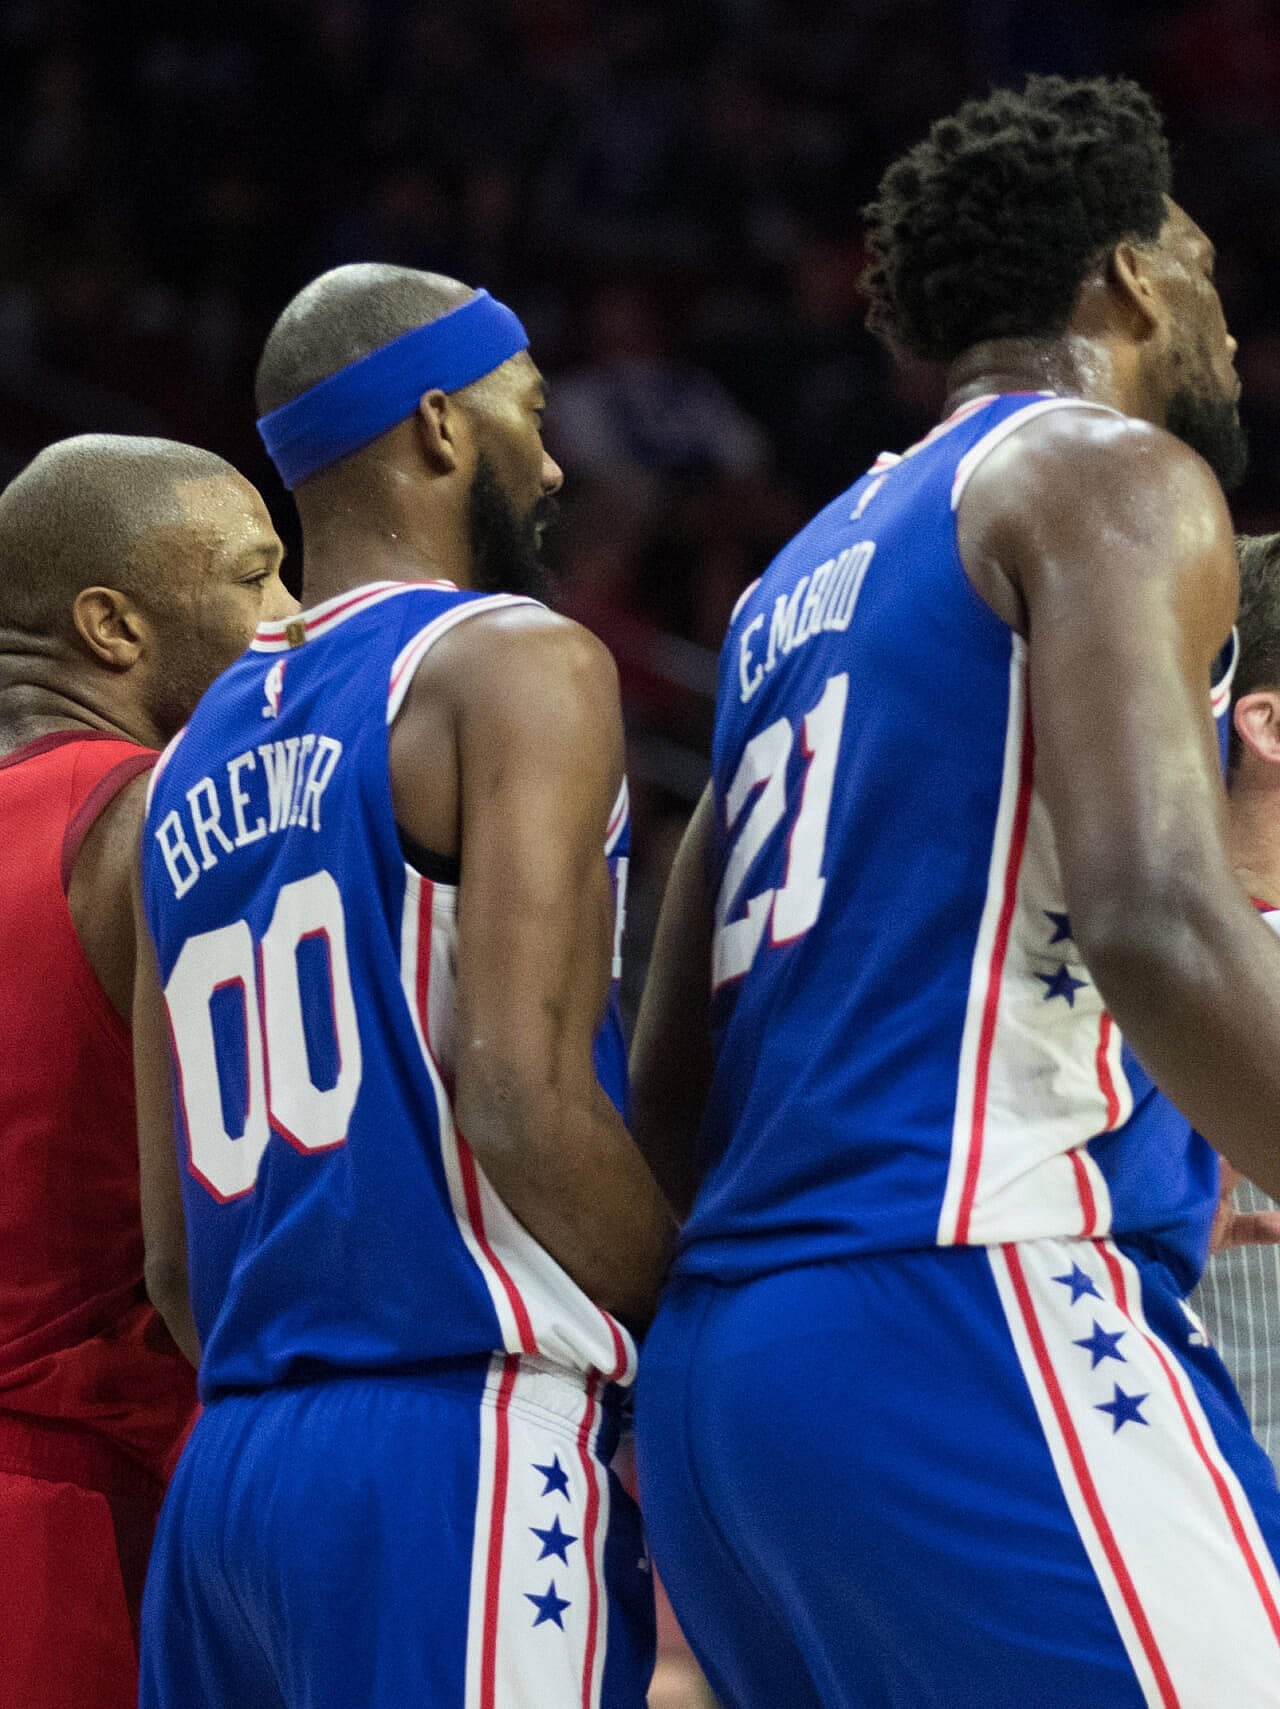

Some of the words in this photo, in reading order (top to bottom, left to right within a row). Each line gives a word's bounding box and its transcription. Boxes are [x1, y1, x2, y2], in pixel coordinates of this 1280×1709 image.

[154, 733, 344, 900] BREWER
[711, 671, 849, 993] 21
[162, 868, 363, 1205] 00
